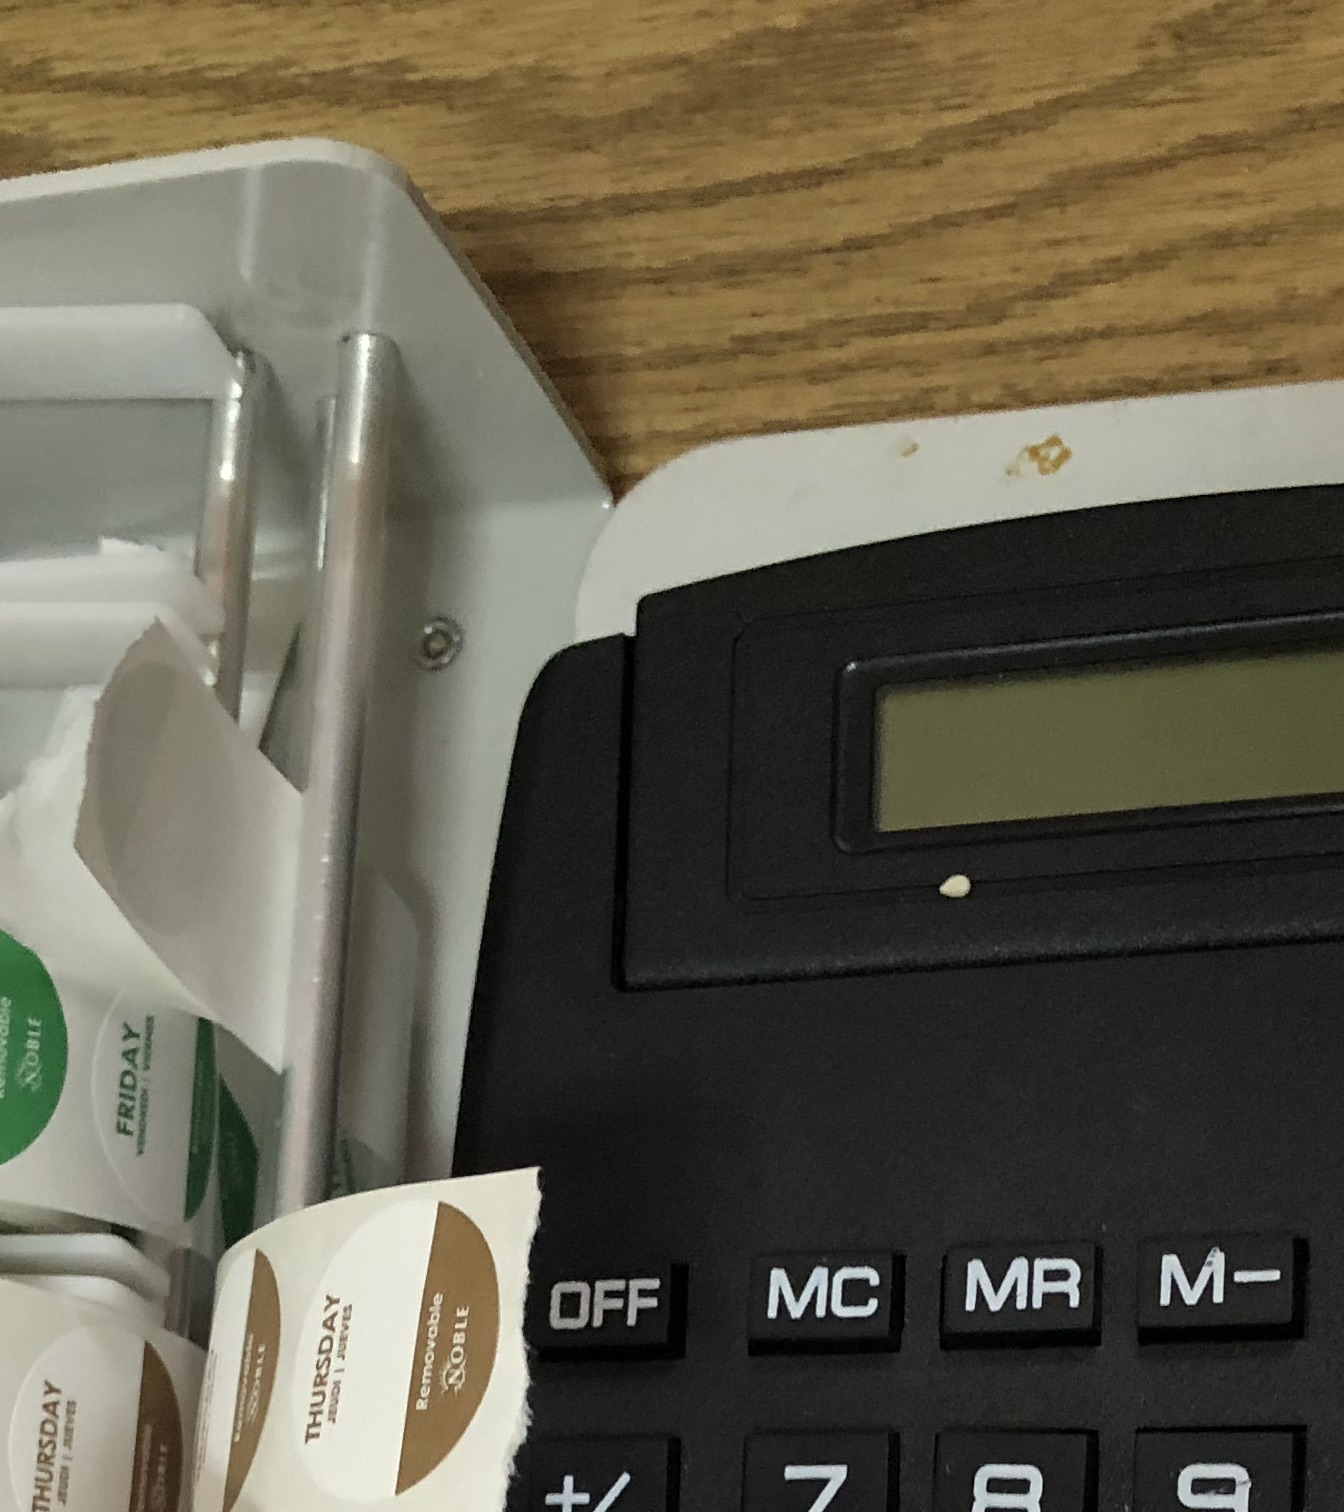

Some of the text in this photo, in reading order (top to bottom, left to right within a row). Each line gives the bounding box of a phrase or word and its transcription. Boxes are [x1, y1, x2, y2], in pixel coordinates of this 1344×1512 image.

[17, 1016, 43, 1093] NOBLE
[116, 1022, 141, 1138] FRIDAY
[548, 1277, 662, 1331] OFF
[766, 1265, 881, 1320] MC
[964, 1255, 1083, 1315] MR
[304, 1293, 341, 1445] THURSDAY
[326, 1303, 353, 1425] JEUDI JUEVES
[415, 1291, 443, 1411] Removable
[439, 1304, 470, 1396] NOBLE
